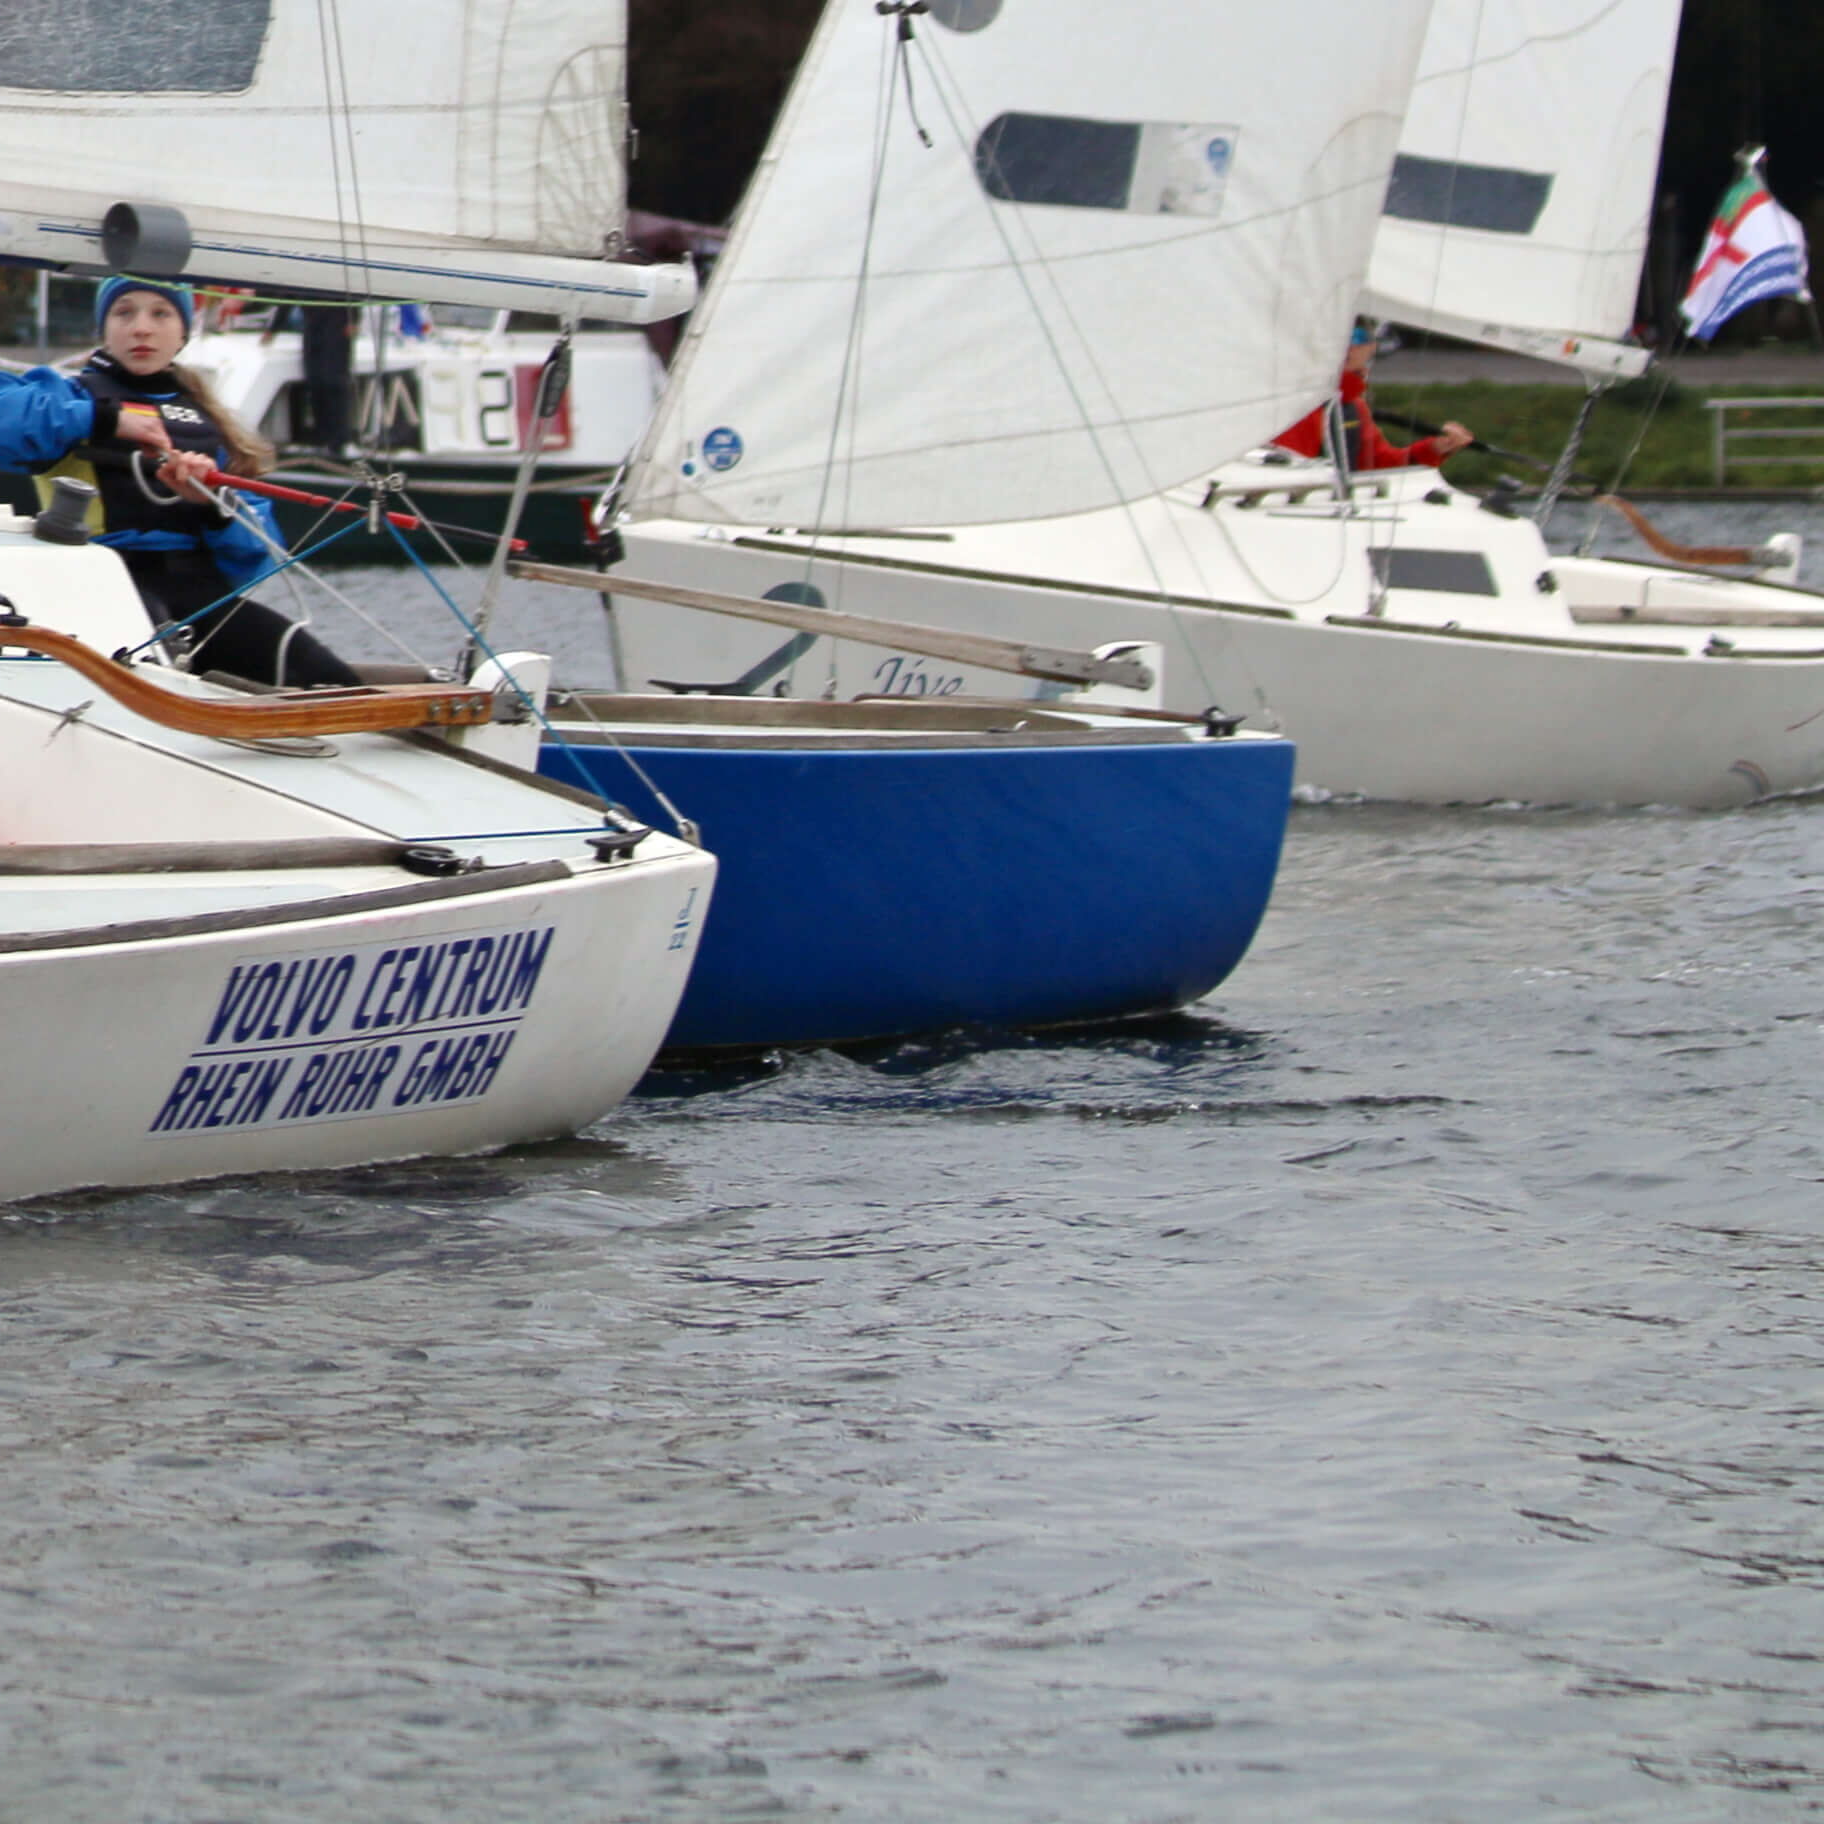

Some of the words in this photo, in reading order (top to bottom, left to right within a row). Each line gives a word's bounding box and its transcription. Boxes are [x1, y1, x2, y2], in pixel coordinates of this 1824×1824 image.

[204, 954, 356, 1044] VOLVO
[352, 926, 555, 1031] CENTRUM
[148, 1056, 294, 1132] RHEIN
[279, 1043, 402, 1120] RUHR
[392, 1029, 517, 1107] GMBH
